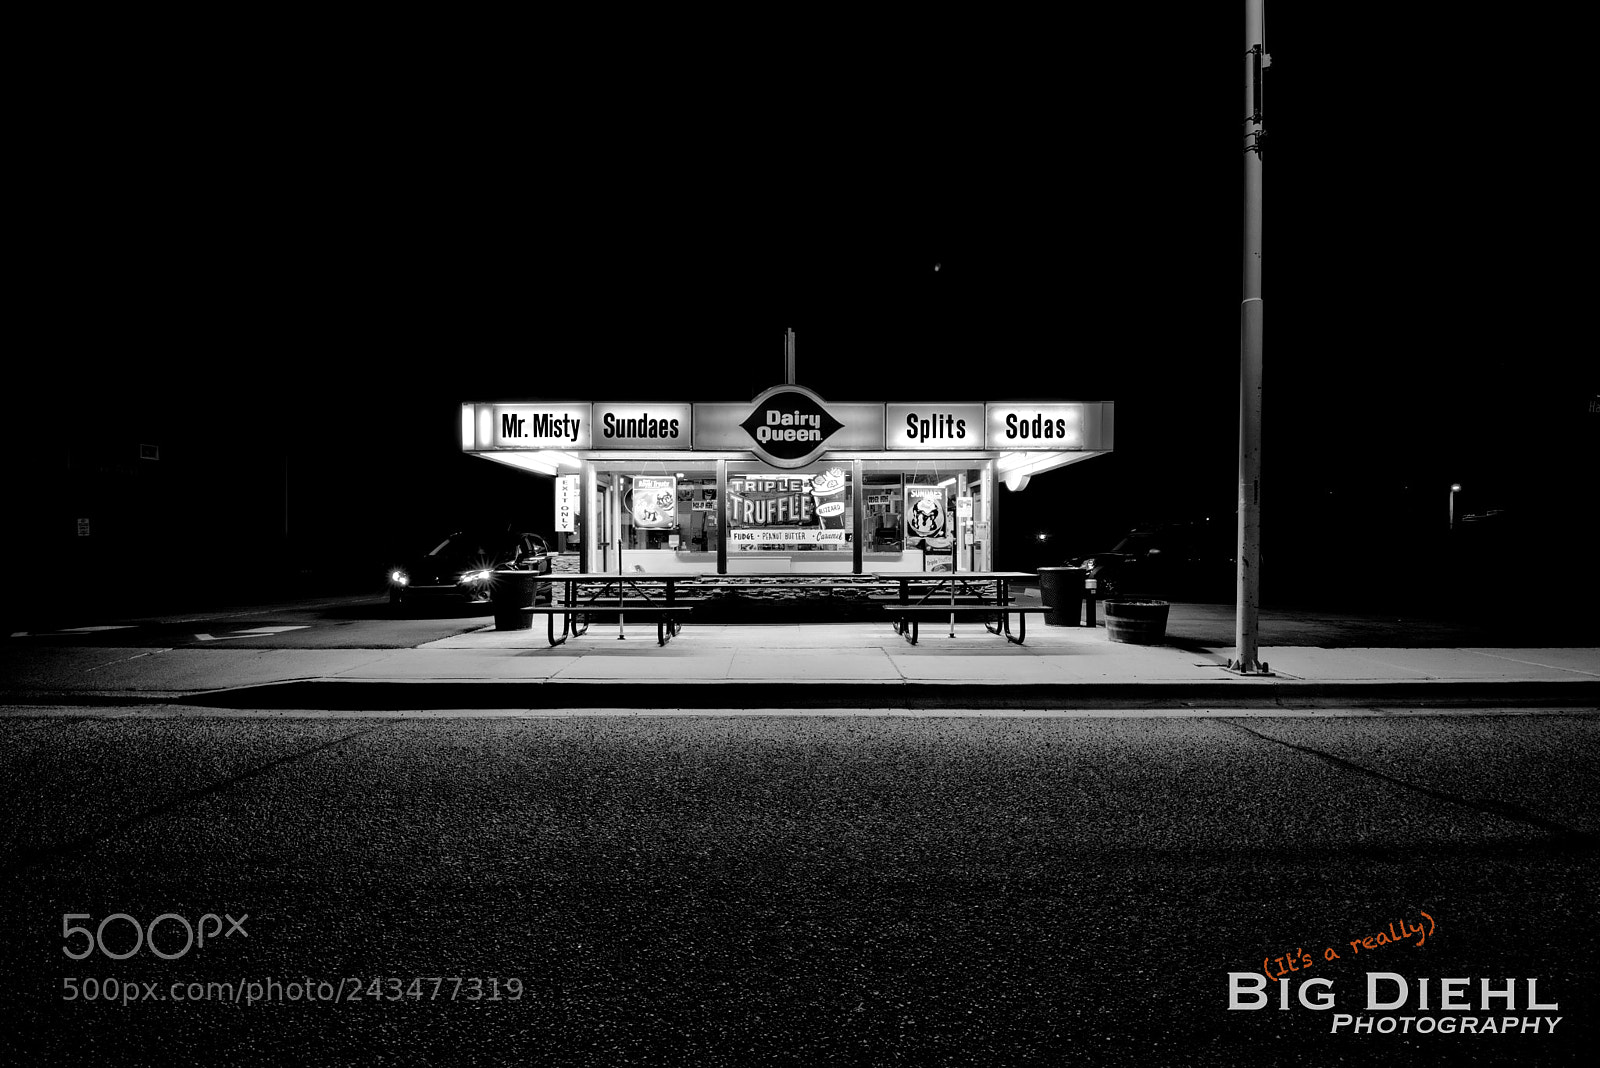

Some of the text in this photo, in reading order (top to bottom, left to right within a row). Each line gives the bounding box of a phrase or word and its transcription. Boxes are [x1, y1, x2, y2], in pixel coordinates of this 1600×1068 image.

[501, 413, 581, 442] Mr. Misty
[603, 412, 679, 439] Sundaes
[767, 410, 820, 428] Dairy
[906, 413, 966, 443] Splits
[1005, 413, 1066, 439] Sodas
[561, 479, 569, 503] EXIT
[731, 480, 802, 492] TRIPLE
[560, 505, 569, 529] ONLY
[730, 494, 811, 524] TRUFFLE
[733, 532, 755, 540] FUDGE
[762, 532, 782, 540] PEANUT
[785, 532, 806, 540] BUTTER
